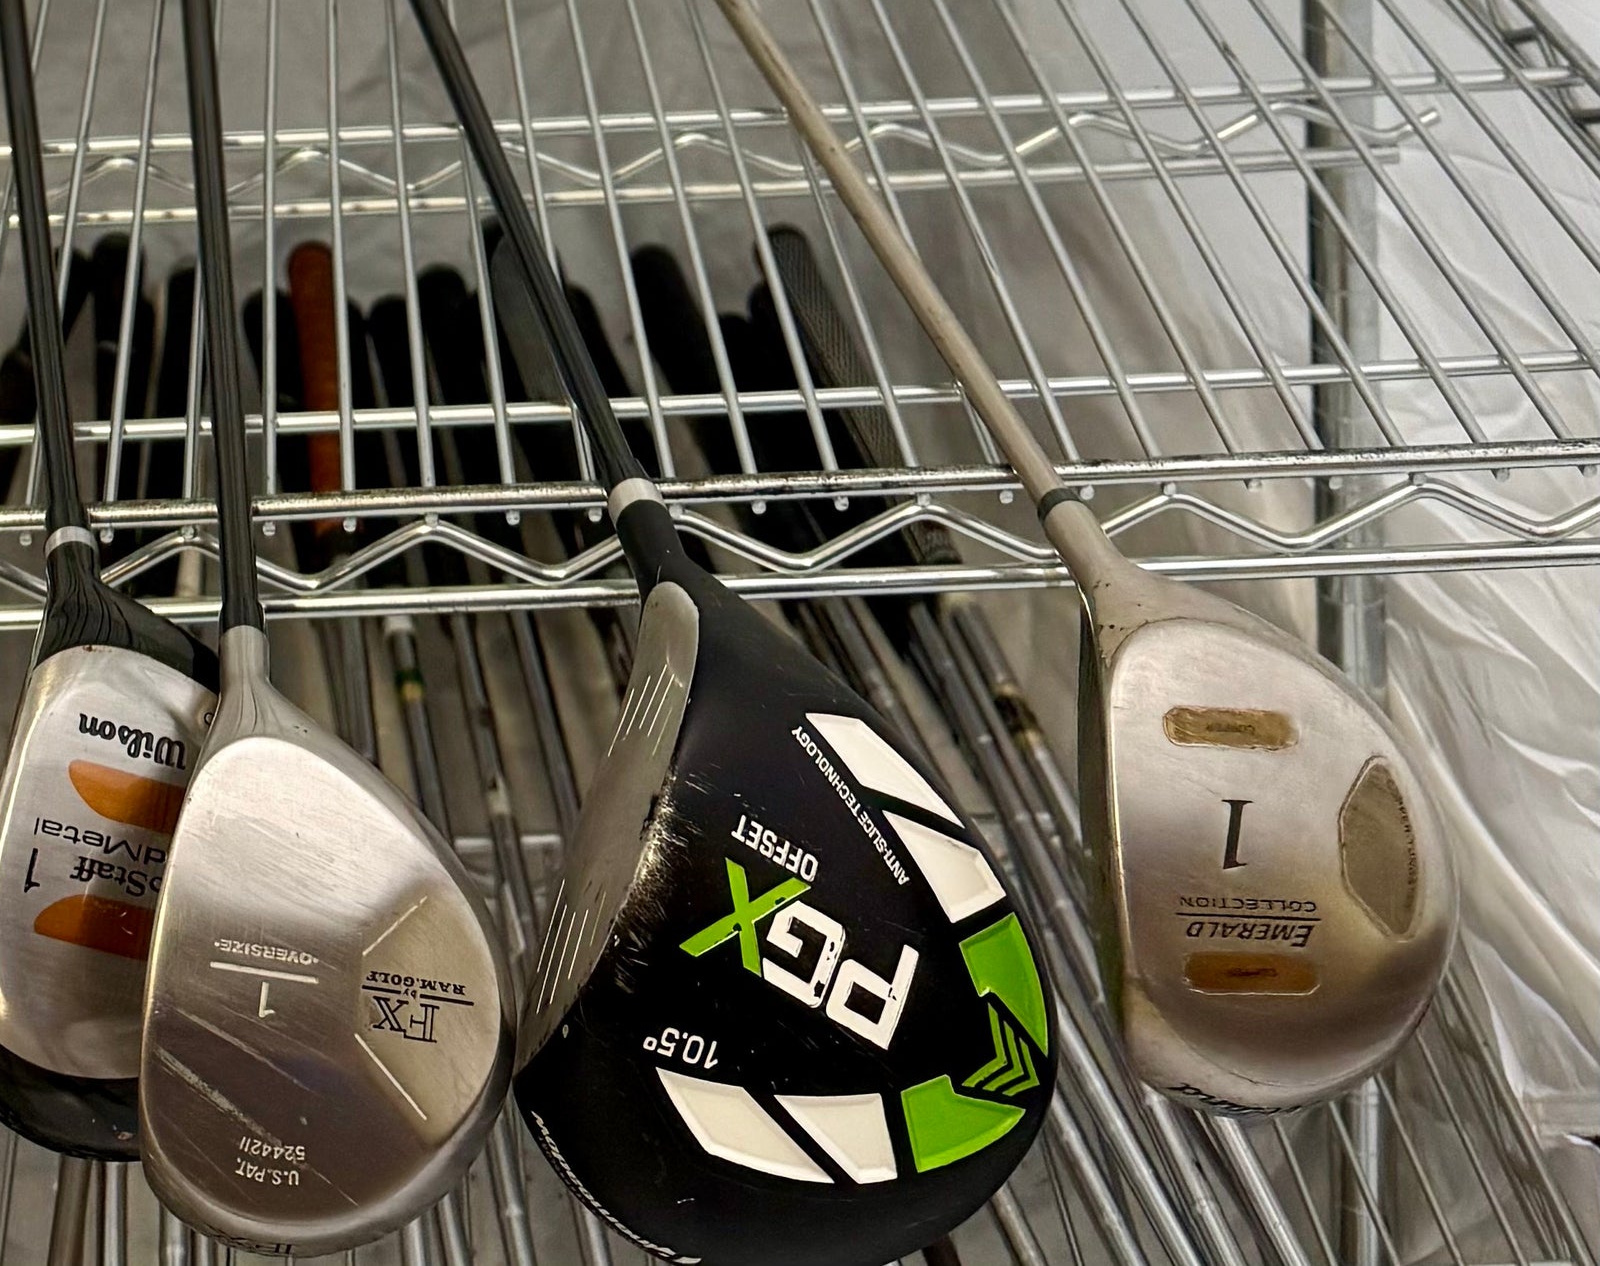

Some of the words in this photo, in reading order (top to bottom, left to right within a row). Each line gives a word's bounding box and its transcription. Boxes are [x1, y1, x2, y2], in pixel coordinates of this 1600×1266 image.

[79, 712, 188, 773] Wilson
[791, 725, 862, 817] TECHNOLOGY
[34, 816, 167, 867] dMetal
[730, 812, 818, 882] OFFSET
[857, 810, 910, 886] ANTI-SLICE
[1220, 798, 1253, 871] 1
[23, 847, 40, 894] 1
[68, 855, 164, 900] oStaff
[1179, 894, 1318, 913] COLLECTION
[678, 856, 920, 1051] PGX
[1185, 919, 1314, 947] EMERALD
[257, 980, 276, 1019] 1
[370, 993, 441, 1044] FX
